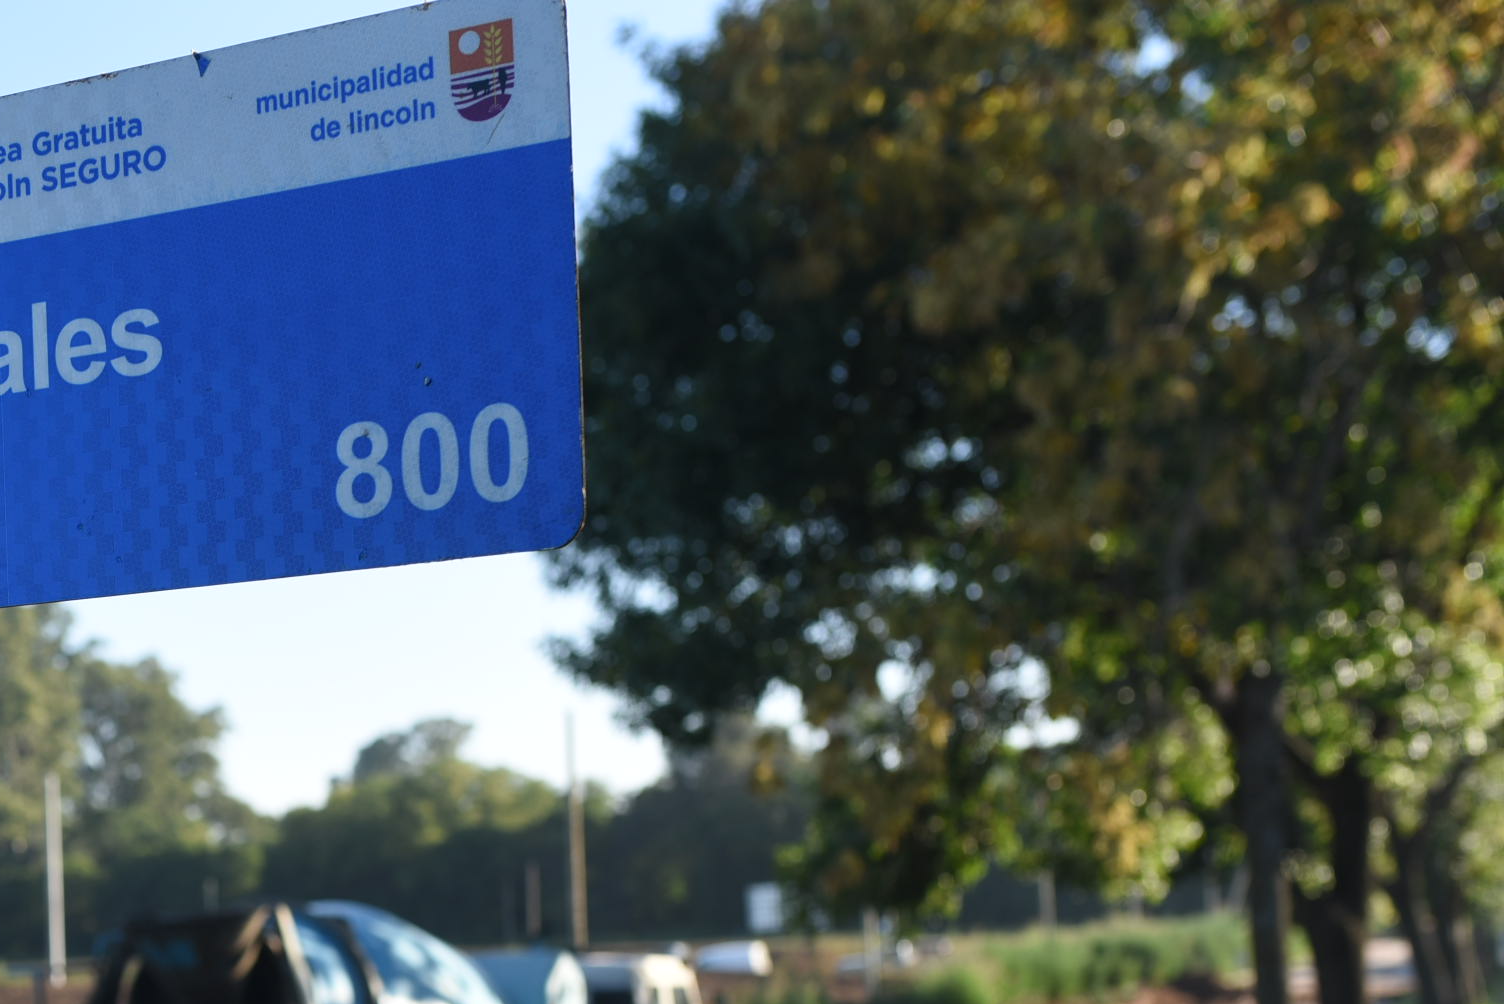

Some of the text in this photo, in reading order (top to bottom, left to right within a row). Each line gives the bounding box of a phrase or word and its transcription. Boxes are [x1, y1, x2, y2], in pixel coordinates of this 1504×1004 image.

[256, 56, 435, 114] municipalidad
[32, 116, 143, 156] Gratuita
[310, 98, 436, 142] de lincoln
[41, 145, 167, 192] SEGURO
[335, 402, 529, 518] 800
